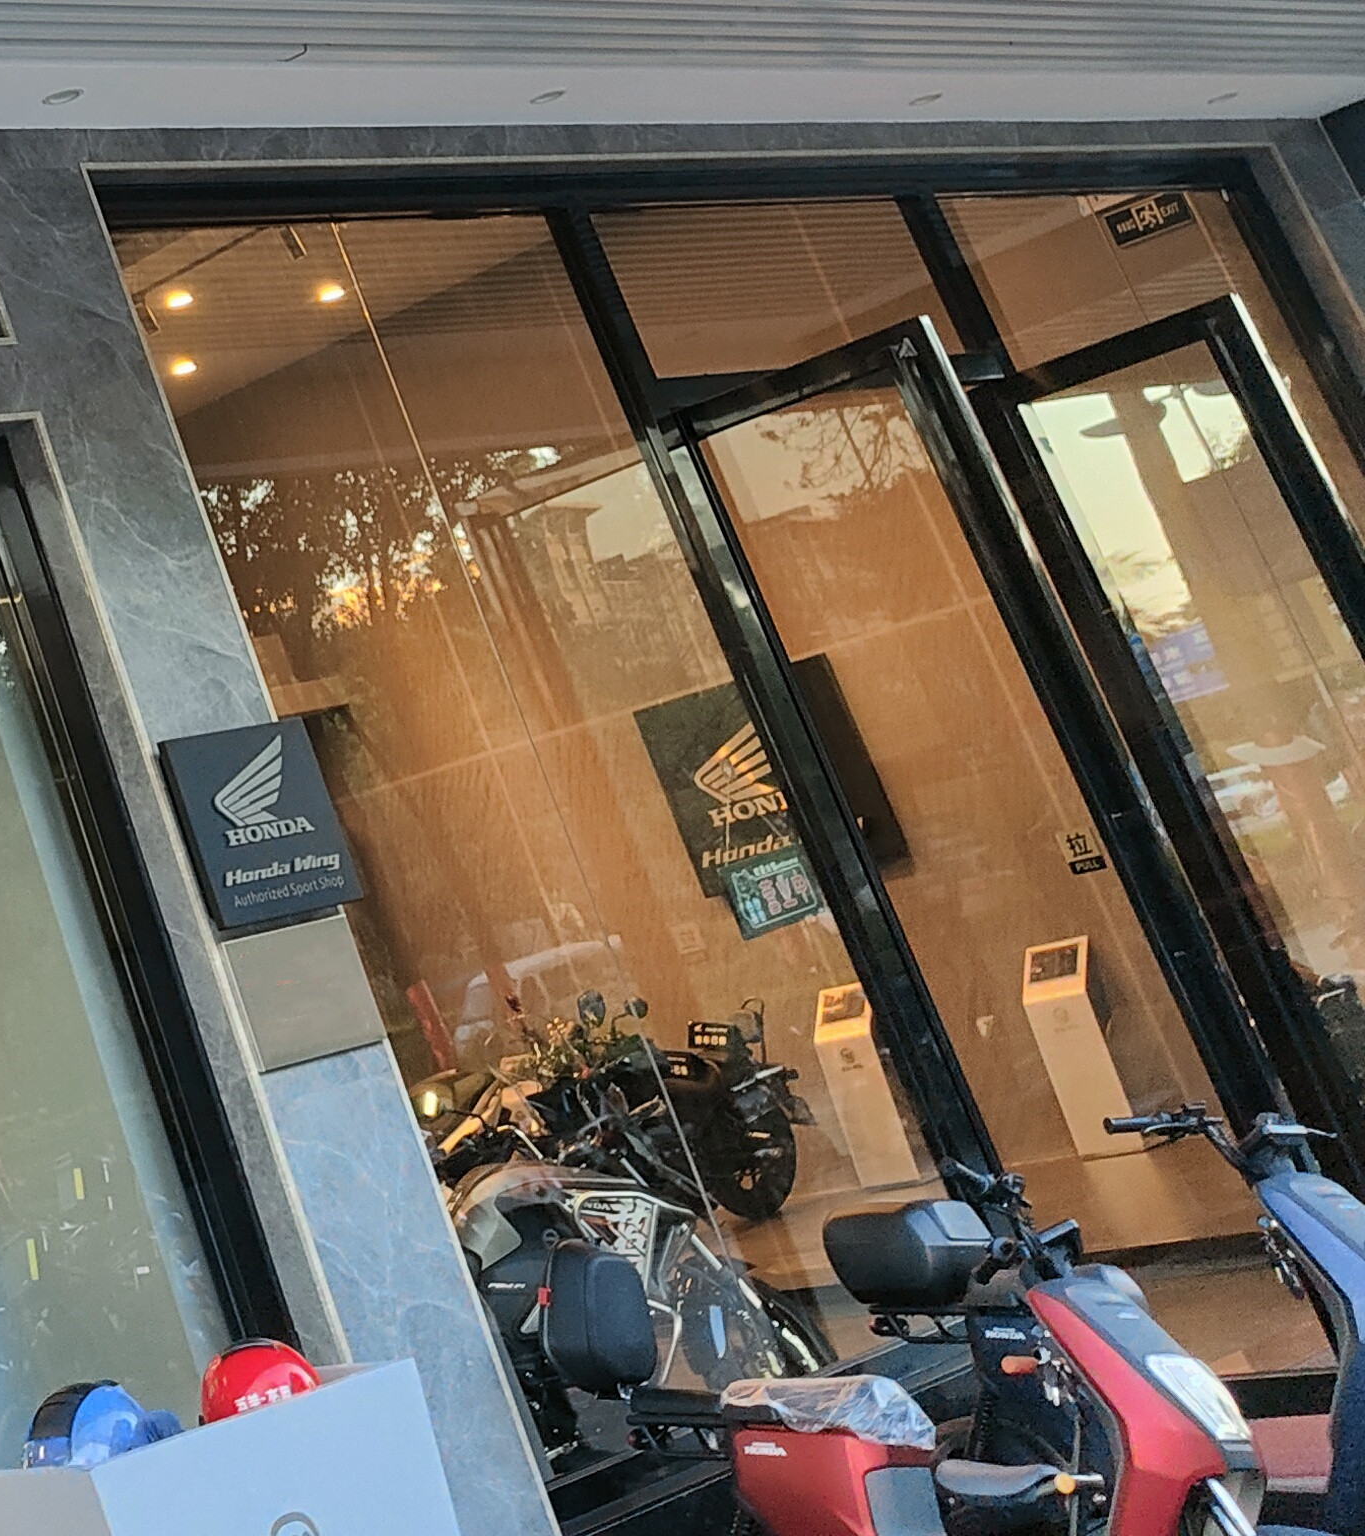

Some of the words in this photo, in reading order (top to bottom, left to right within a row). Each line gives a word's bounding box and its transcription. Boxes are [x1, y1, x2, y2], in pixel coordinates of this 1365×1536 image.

[706, 791, 789, 828] HON
[224, 816, 316, 847] HONDA
[1066, 832, 1094, 857] 拉
[701, 833, 792, 869] Honda
[1074, 858, 1101, 873] PULL
[225, 861, 291, 887] Honda
[292, 853, 340, 872] Wing
[233, 884, 290, 909] Authorized
[289, 879, 319, 897] Sport
[317, 875, 345, 889] Shop
